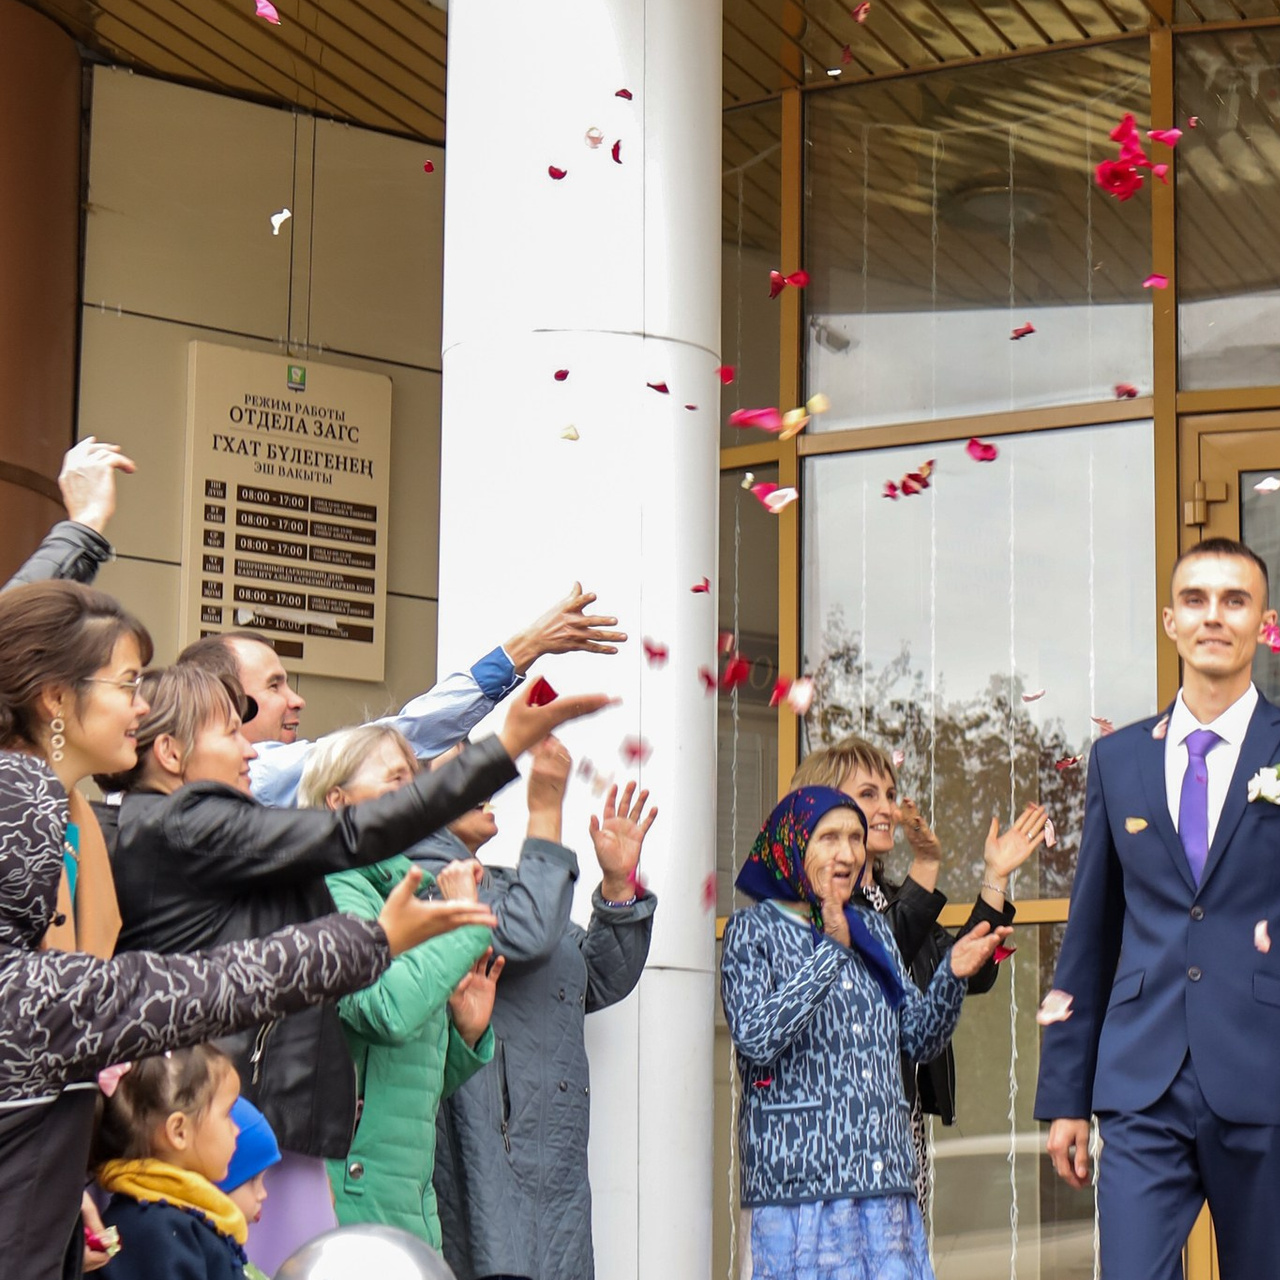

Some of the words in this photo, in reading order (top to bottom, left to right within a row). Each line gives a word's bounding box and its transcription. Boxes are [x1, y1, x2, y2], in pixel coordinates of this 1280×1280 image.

[244, 393, 291, 412] РЕЖИМ
[295, 403, 345, 422] РАБОТЫ
[229, 405, 308, 435] ОТДЕЛА
[313, 420, 360, 443] ЗАГС
[212, 433, 261, 457] ГХАТ
[254, 461, 274, 474] ЭШ
[278, 465, 332, 485] ВАКЫТЫ
[241, 488, 270, 503] 08:00
[279, 494, 304, 508] 17:00
[241, 513, 269, 528] 08:00
[279, 518, 304, 532] 17:00
[240, 537, 268, 552] 08:00
[278, 543, 303, 557] 17:00
[238, 588, 267, 602] 08:00
[276, 593, 301, 606] 17:00
